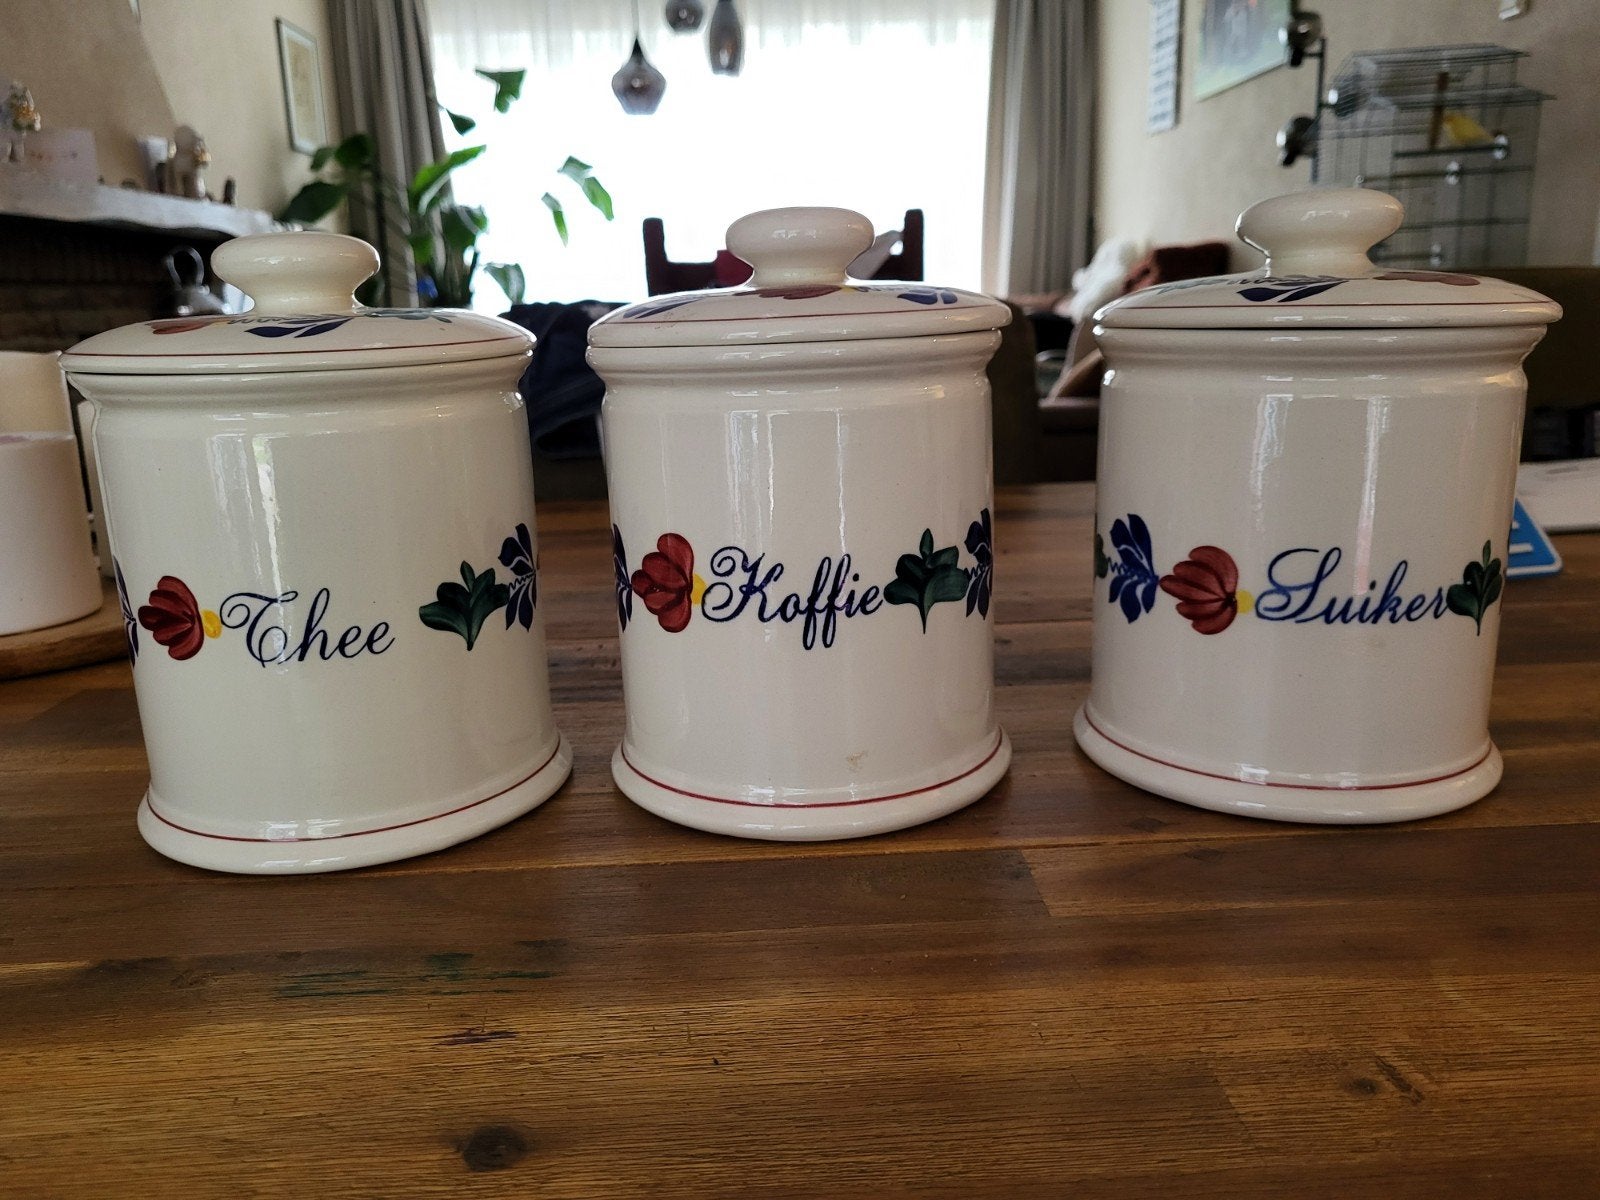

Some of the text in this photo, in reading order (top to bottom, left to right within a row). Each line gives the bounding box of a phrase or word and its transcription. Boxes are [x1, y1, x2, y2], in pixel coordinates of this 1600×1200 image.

[701, 546, 883, 650] Koffie
[1255, 547, 1449, 624] Suiker
[219, 587, 396, 668] Thee
